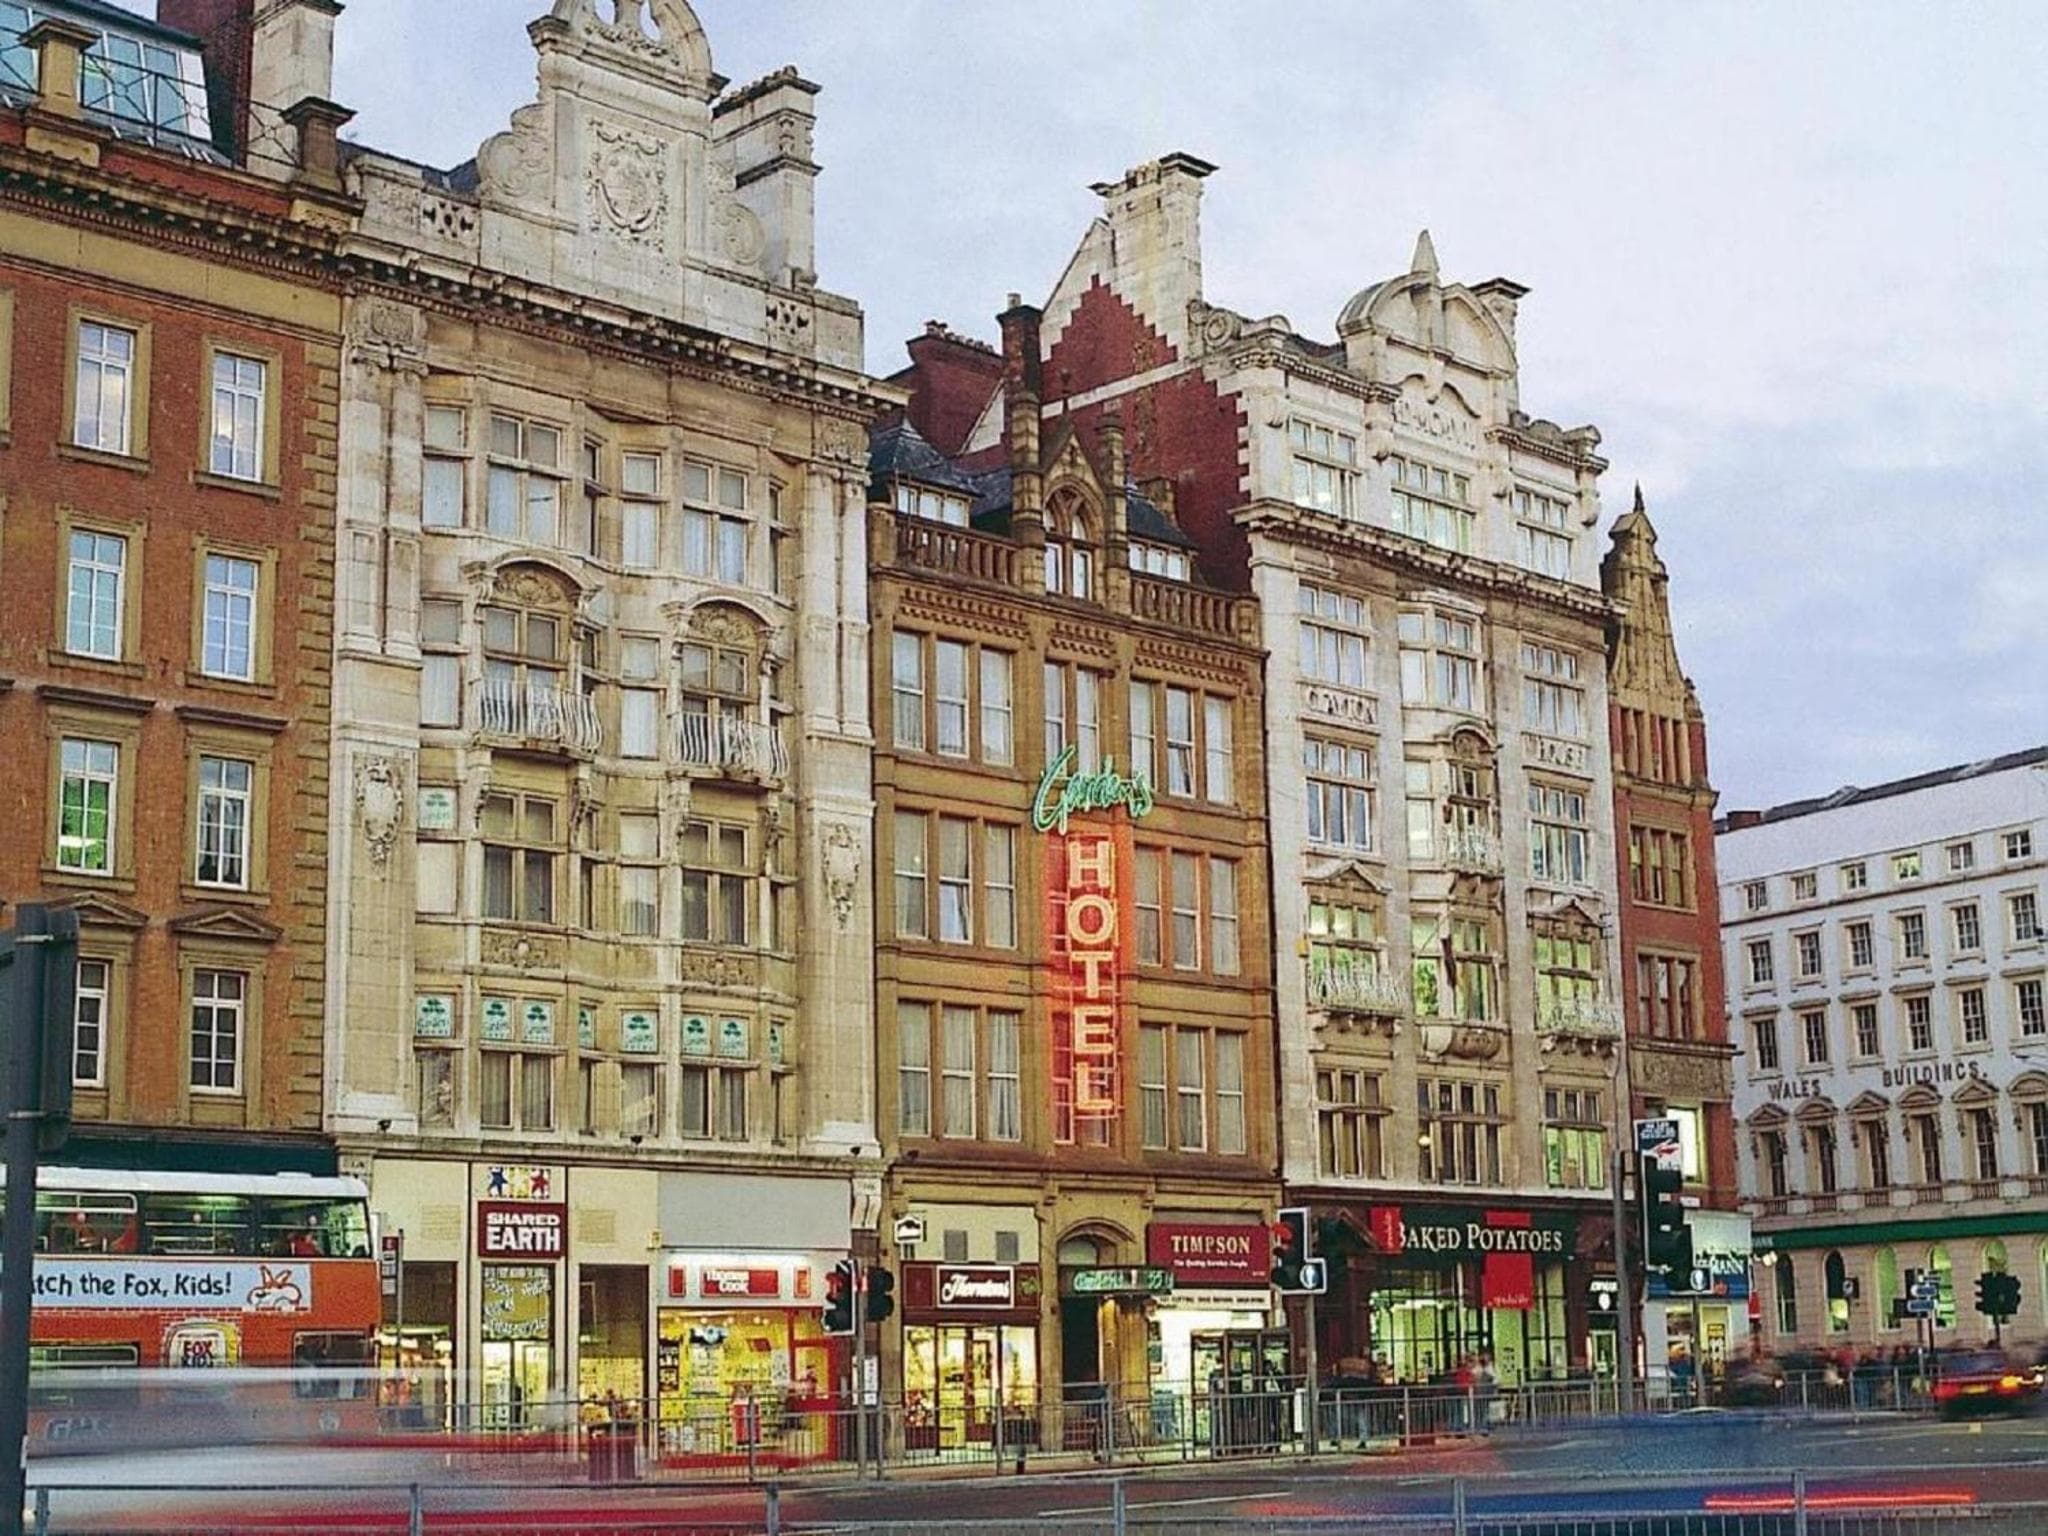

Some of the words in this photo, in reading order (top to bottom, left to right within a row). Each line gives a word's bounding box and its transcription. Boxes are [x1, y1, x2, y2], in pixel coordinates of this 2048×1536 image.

[1068, 839, 1115, 1111] HOTEL
[1767, 1079, 1821, 1100] WALES
[486, 1212, 561, 1226] SHARED
[486, 1226, 561, 1251] EARTH
[1170, 1235, 1250, 1254] TIMPSON
[1466, 1222, 1563, 1251] POTATOES
[80, 1272, 115, 1295] the
[124, 1273, 168, 1298] Fox,
[175, 1272, 231, 1297] Kids!
[941, 1273, 1010, 1303] Thorntons
[183, 1340, 214, 1357] FOX
